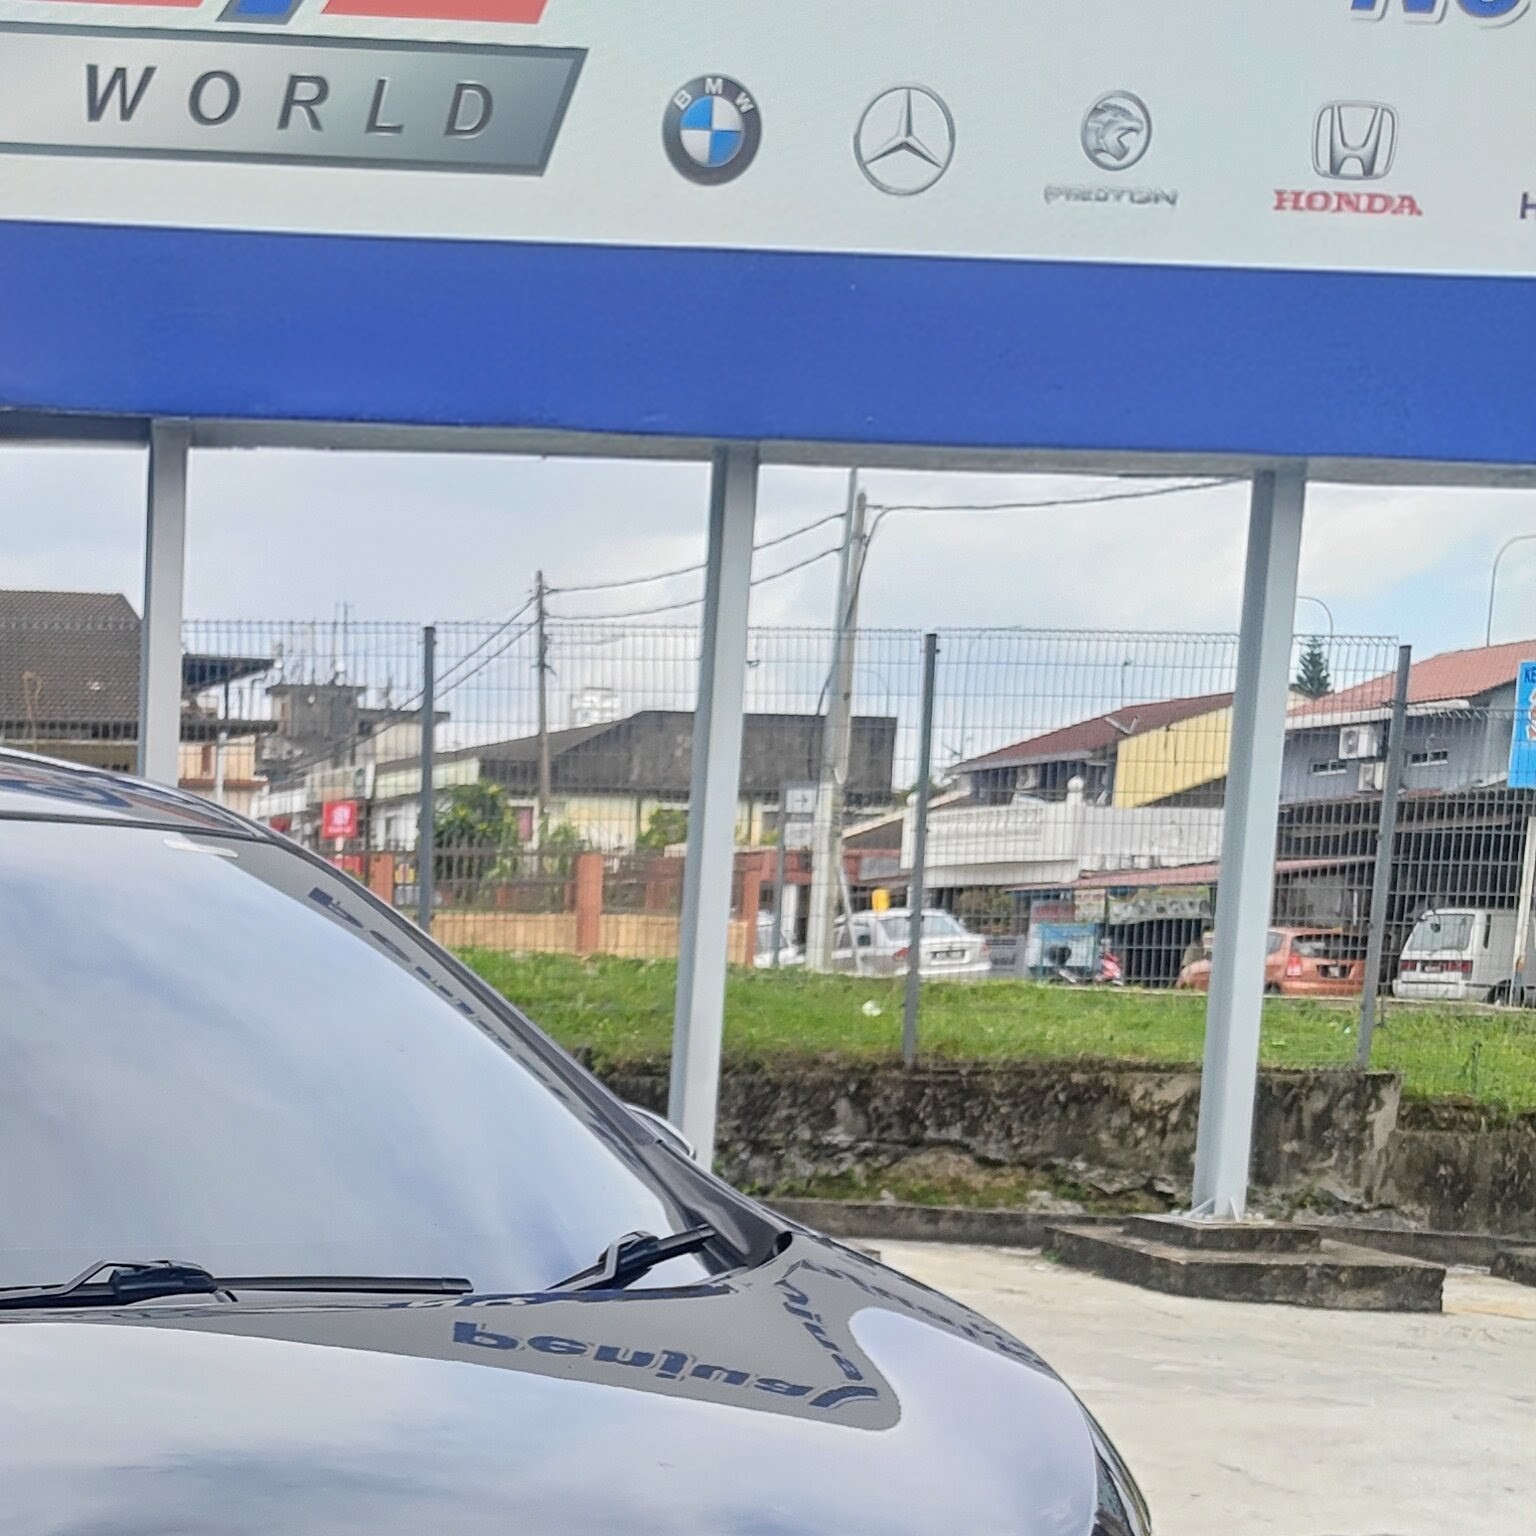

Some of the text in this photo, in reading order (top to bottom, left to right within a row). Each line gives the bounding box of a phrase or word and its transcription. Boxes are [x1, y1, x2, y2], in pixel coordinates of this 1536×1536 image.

[84, 63, 495, 139] WORLD
[673, 77, 754, 114] BMW
[1044, 185, 1178, 206] PROTON
[1273, 189, 1423, 217] HONDA
